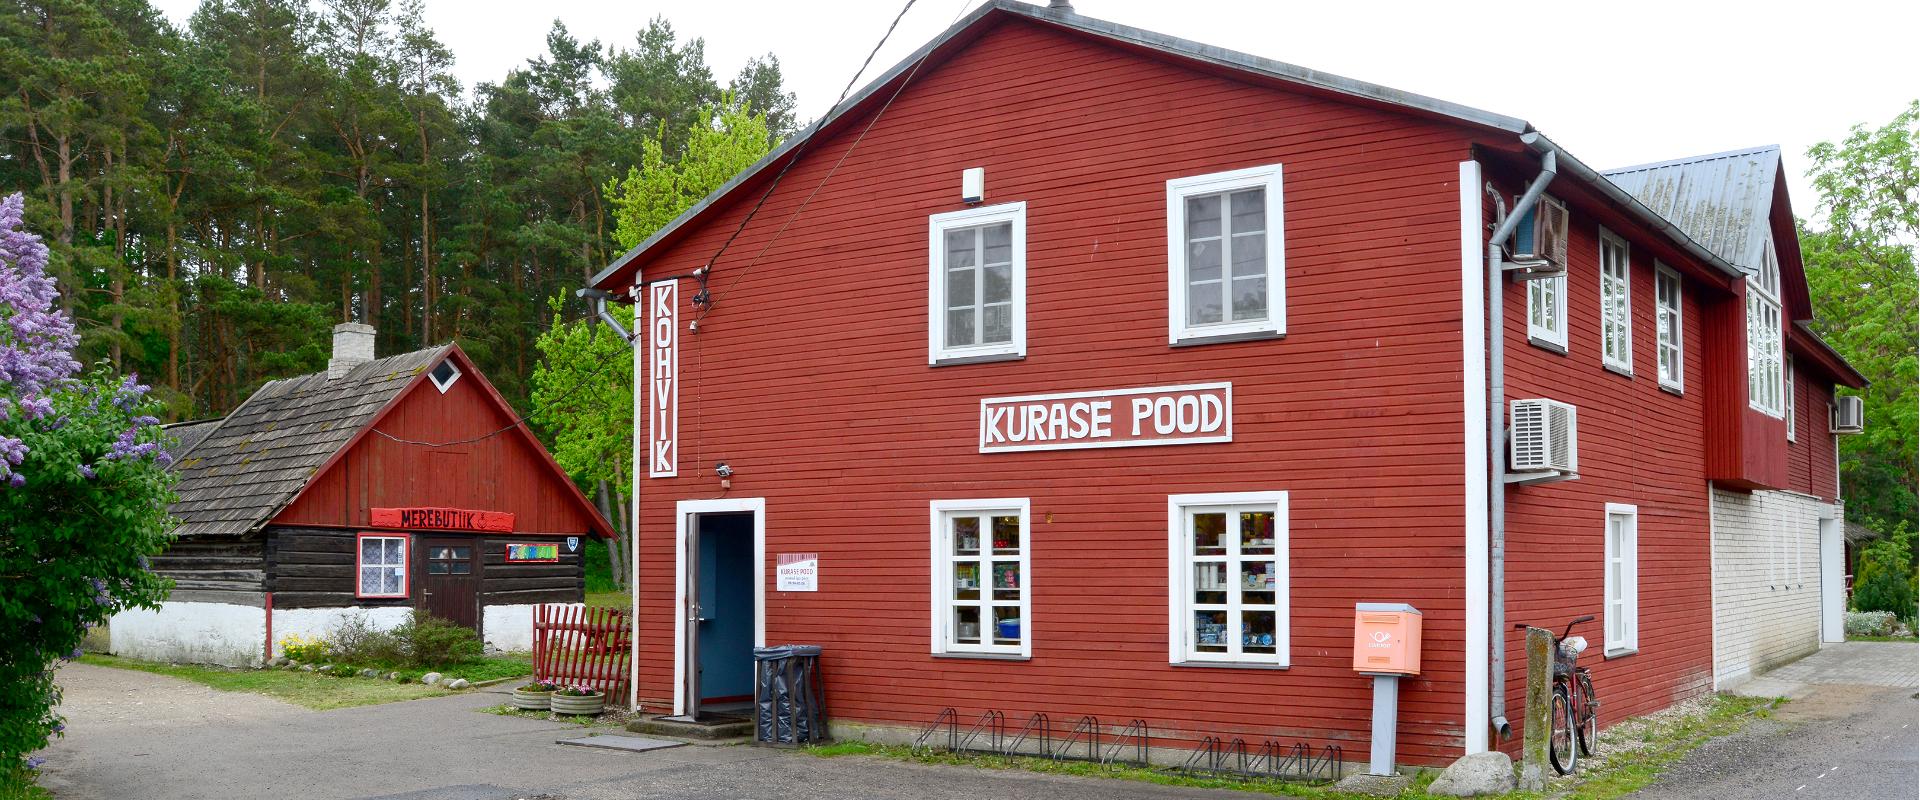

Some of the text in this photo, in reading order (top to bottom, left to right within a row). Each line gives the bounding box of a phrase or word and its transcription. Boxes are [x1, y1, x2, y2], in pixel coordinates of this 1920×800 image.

[656, 286, 672, 472] KOHVIK
[985, 394, 1223, 443] KURASE POOD
